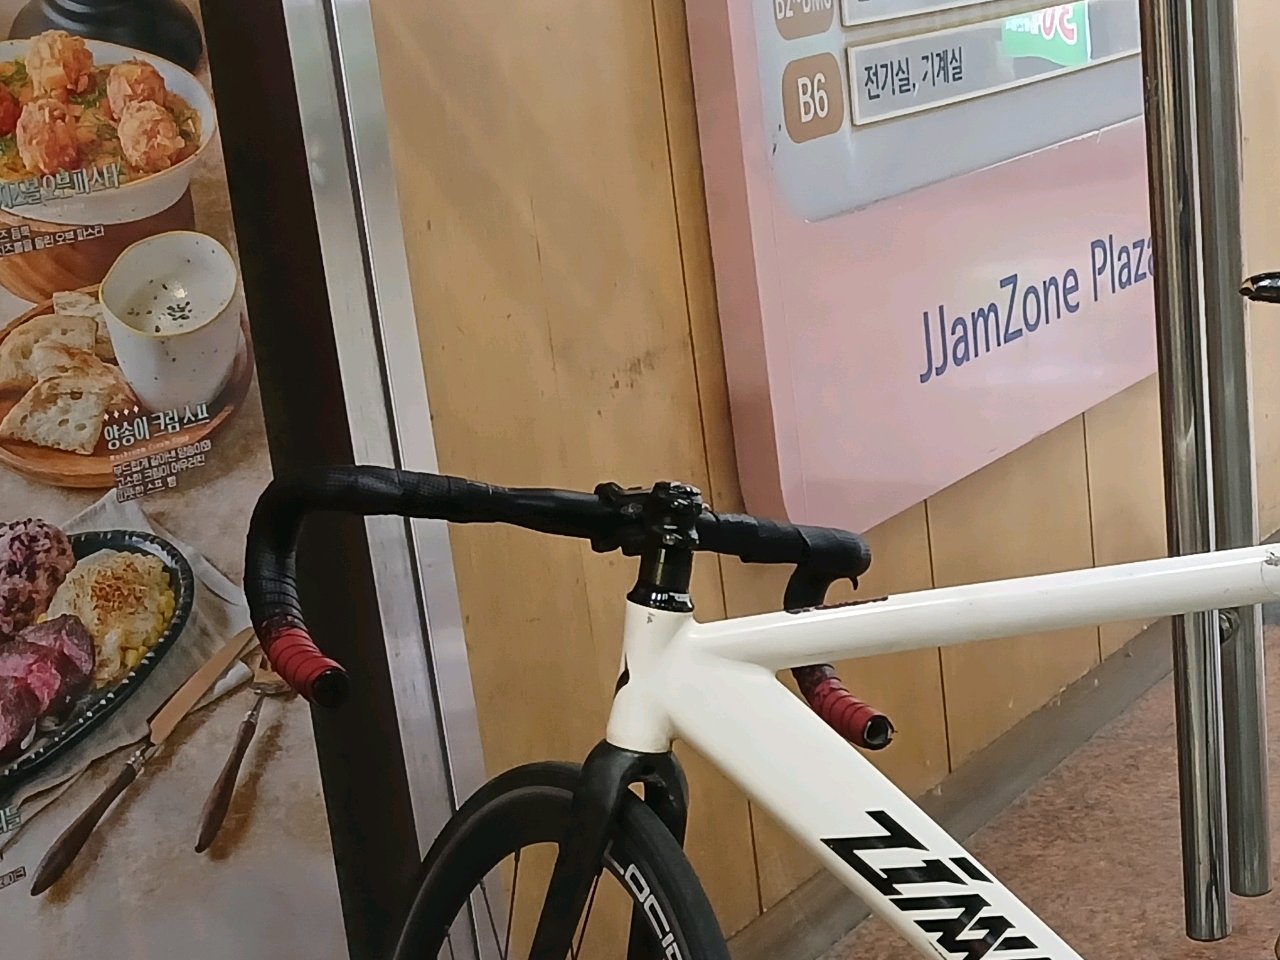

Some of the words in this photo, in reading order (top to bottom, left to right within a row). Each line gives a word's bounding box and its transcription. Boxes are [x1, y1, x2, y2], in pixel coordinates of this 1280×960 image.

[921, 46, 963, 87] 기계실
[797, 73, 829, 123] B6
[76, 225, 104, 241] 파스타
[919, 268, 1080, 383] JJamZone
[104, 416, 149, 450] 양송이
[151, 408, 180, 436] 크림
[184, 403, 210, 428] 스프
[147, 480, 165, 494] 스프
